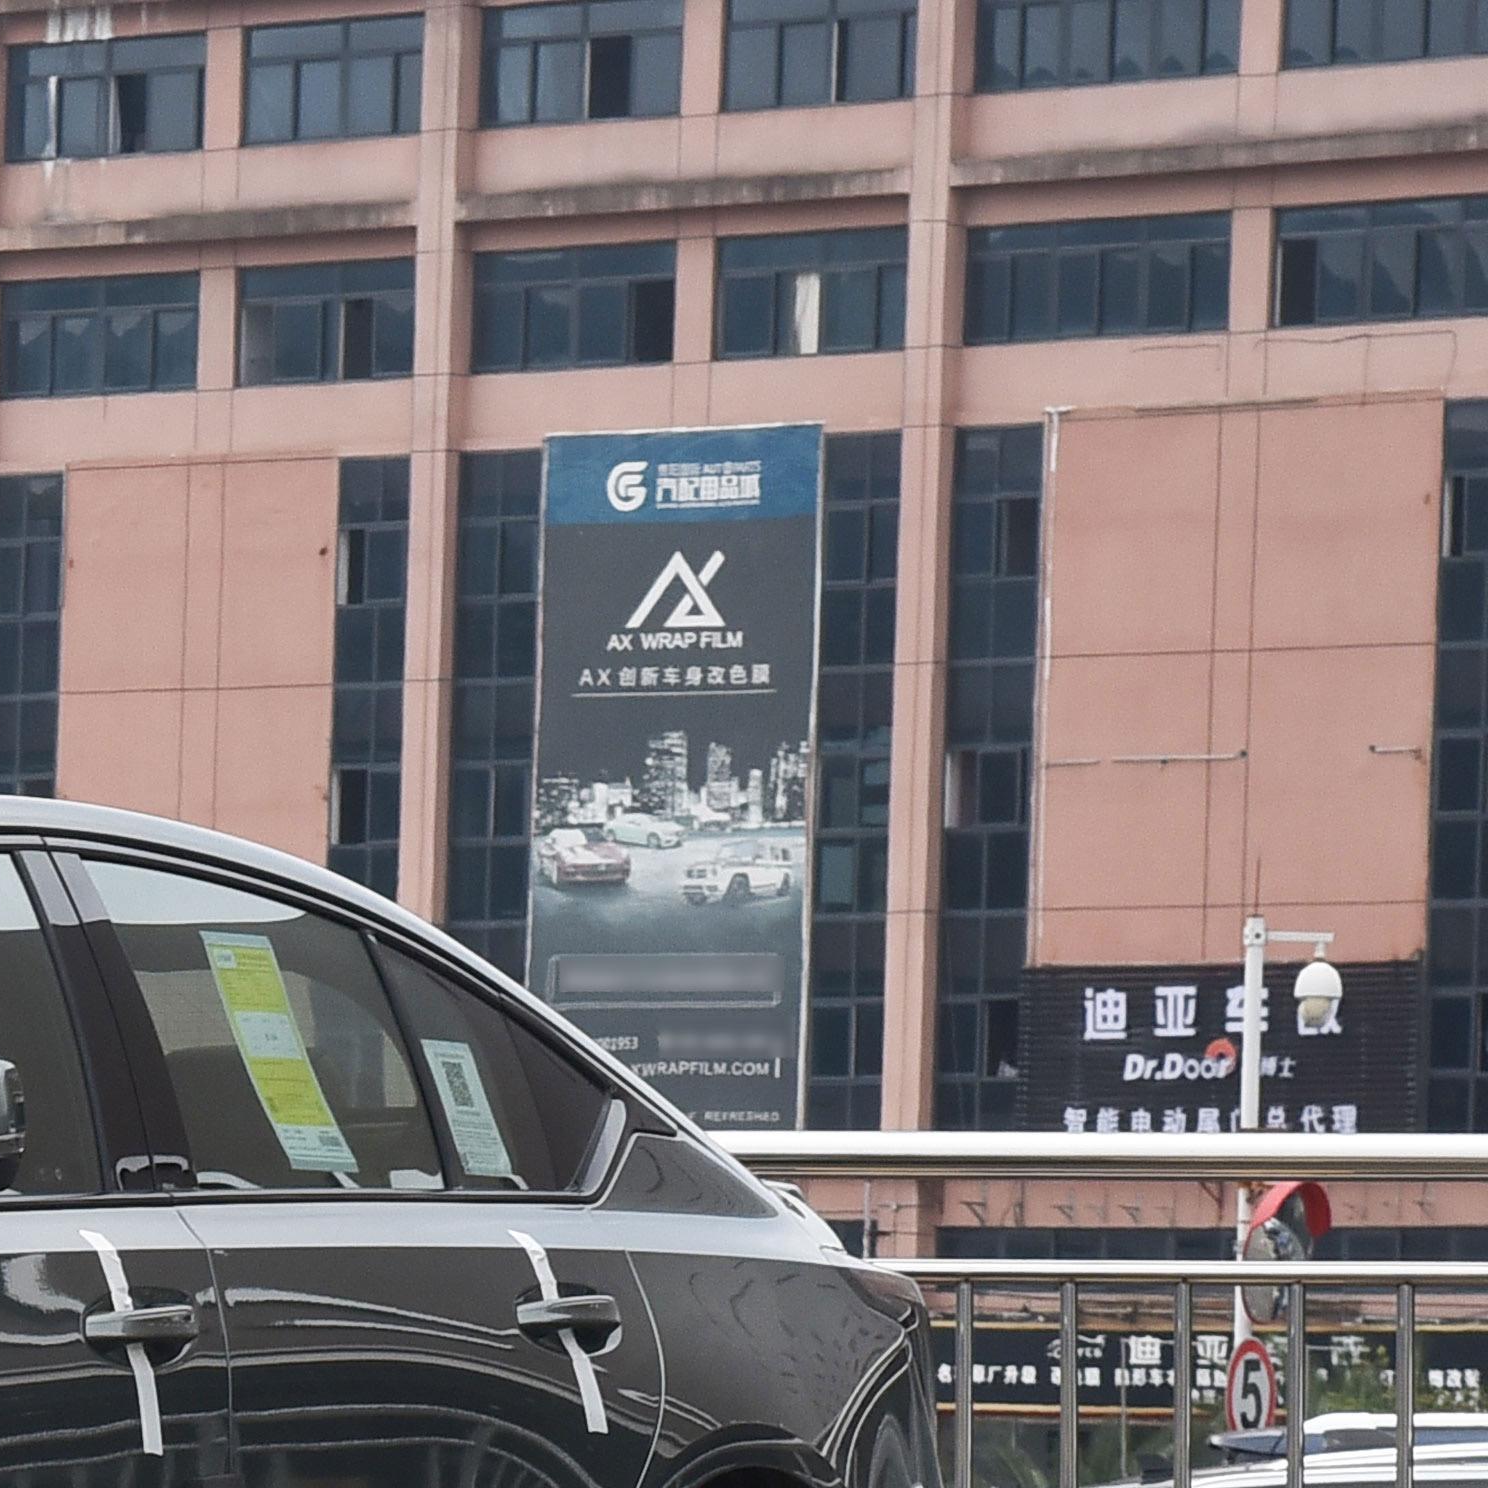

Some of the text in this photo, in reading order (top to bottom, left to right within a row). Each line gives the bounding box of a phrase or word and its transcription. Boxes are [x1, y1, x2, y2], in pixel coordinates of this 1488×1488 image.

[606, 630, 744, 651] AX WRAP FILM
[578, 663, 771, 687] AX 创新车身改色膜
[1123, 1053, 1230, 1081] Dr.Door
[1240, 1358, 1262, 1429] 5
